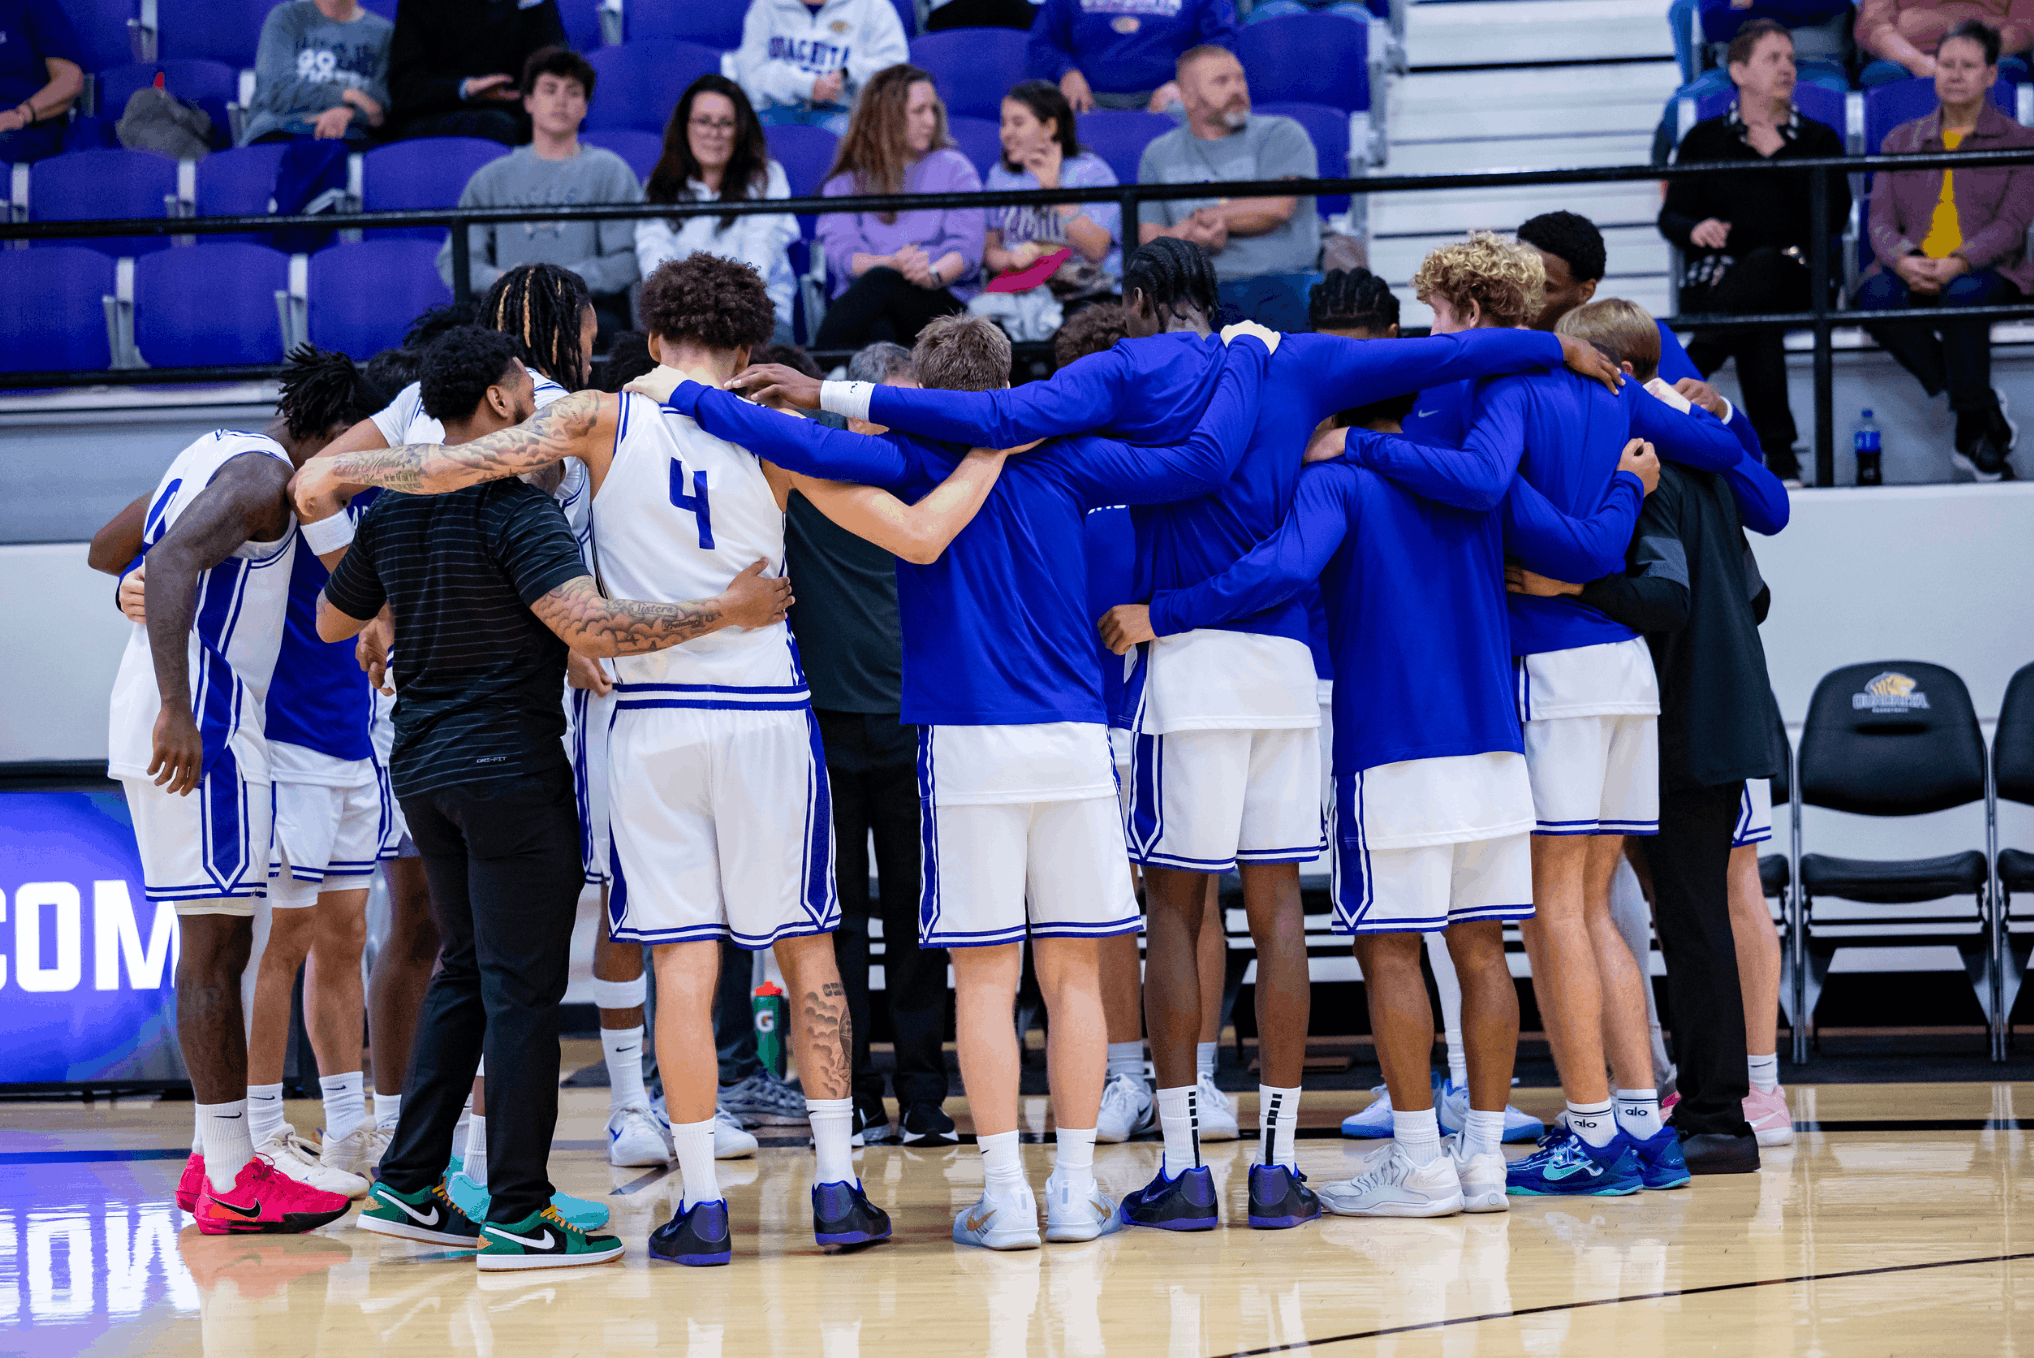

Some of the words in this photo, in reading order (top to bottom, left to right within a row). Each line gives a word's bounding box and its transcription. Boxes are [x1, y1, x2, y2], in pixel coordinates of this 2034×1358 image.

[668, 456, 715, 550] 4
[0, 880, 181, 992] OM
[755, 1009, 775, 1034] G
[1574, 1119, 1597, 1128] alo
[1625, 1106, 1648, 1116] alo
